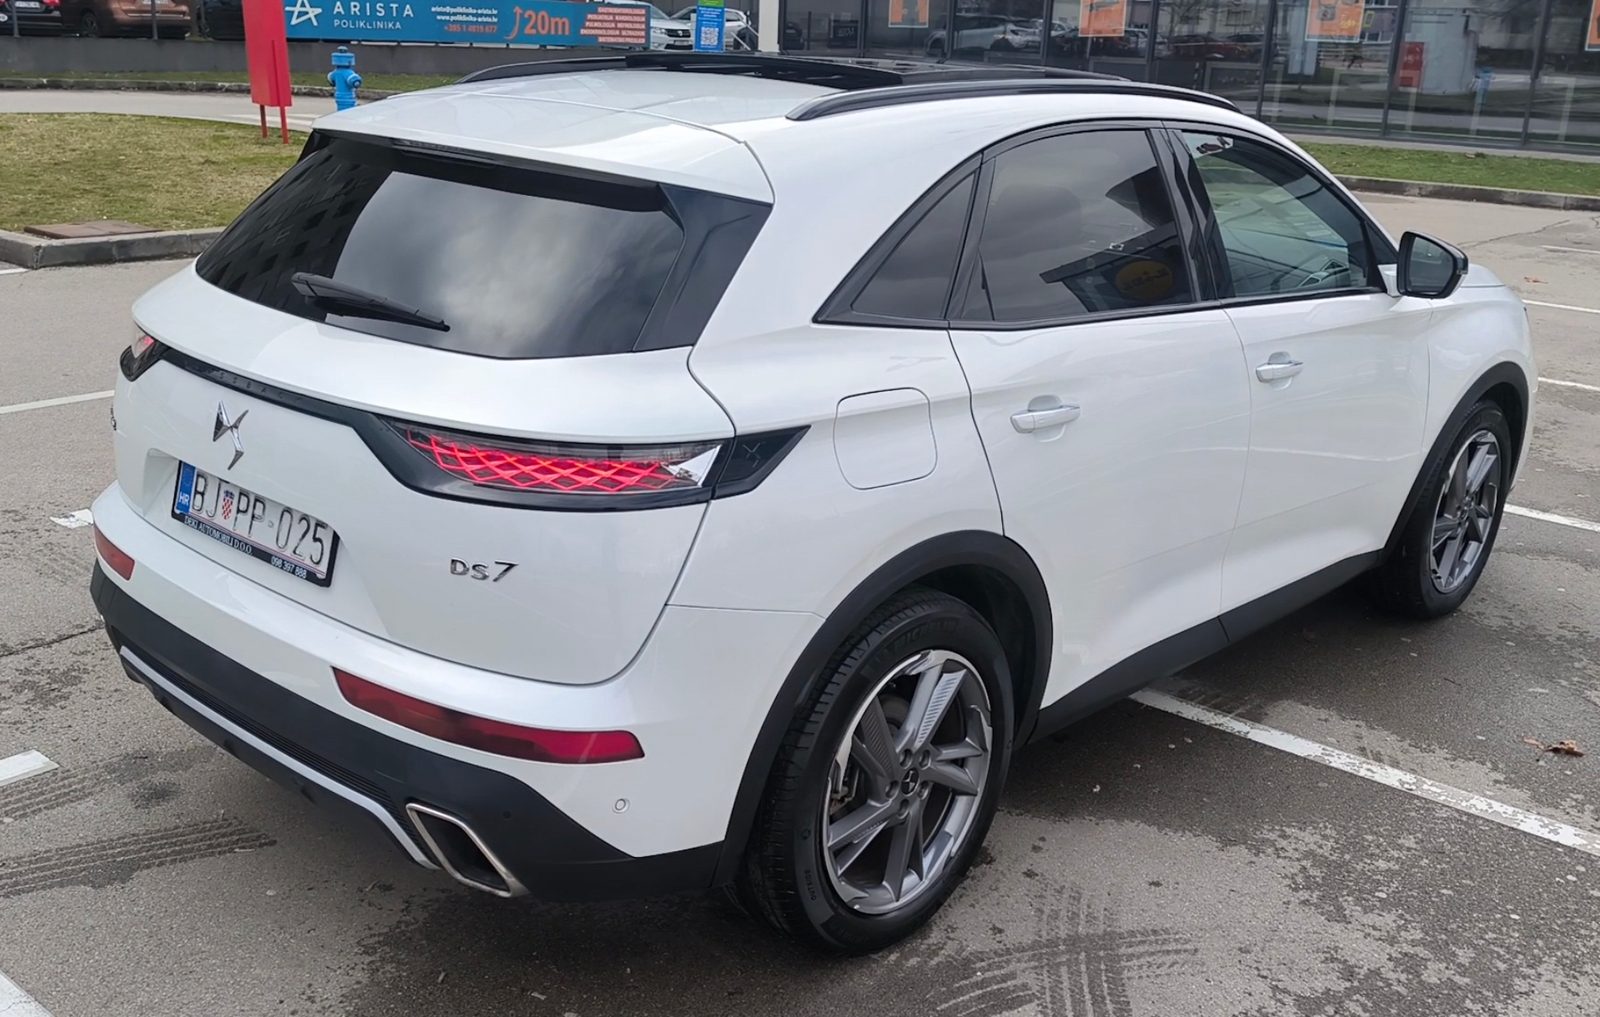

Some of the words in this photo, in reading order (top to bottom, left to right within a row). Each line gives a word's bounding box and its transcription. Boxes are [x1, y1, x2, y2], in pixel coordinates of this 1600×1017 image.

[333, 1, 414, 17] ARISTA
[333, 19, 401, 30] POLIKLINIKA
[524, 10, 570, 35] 20m
[179, 491, 190, 506] HR
[192, 473, 221, 519] BJ
[198, 522, 233, 547] AUTOMOBILI
